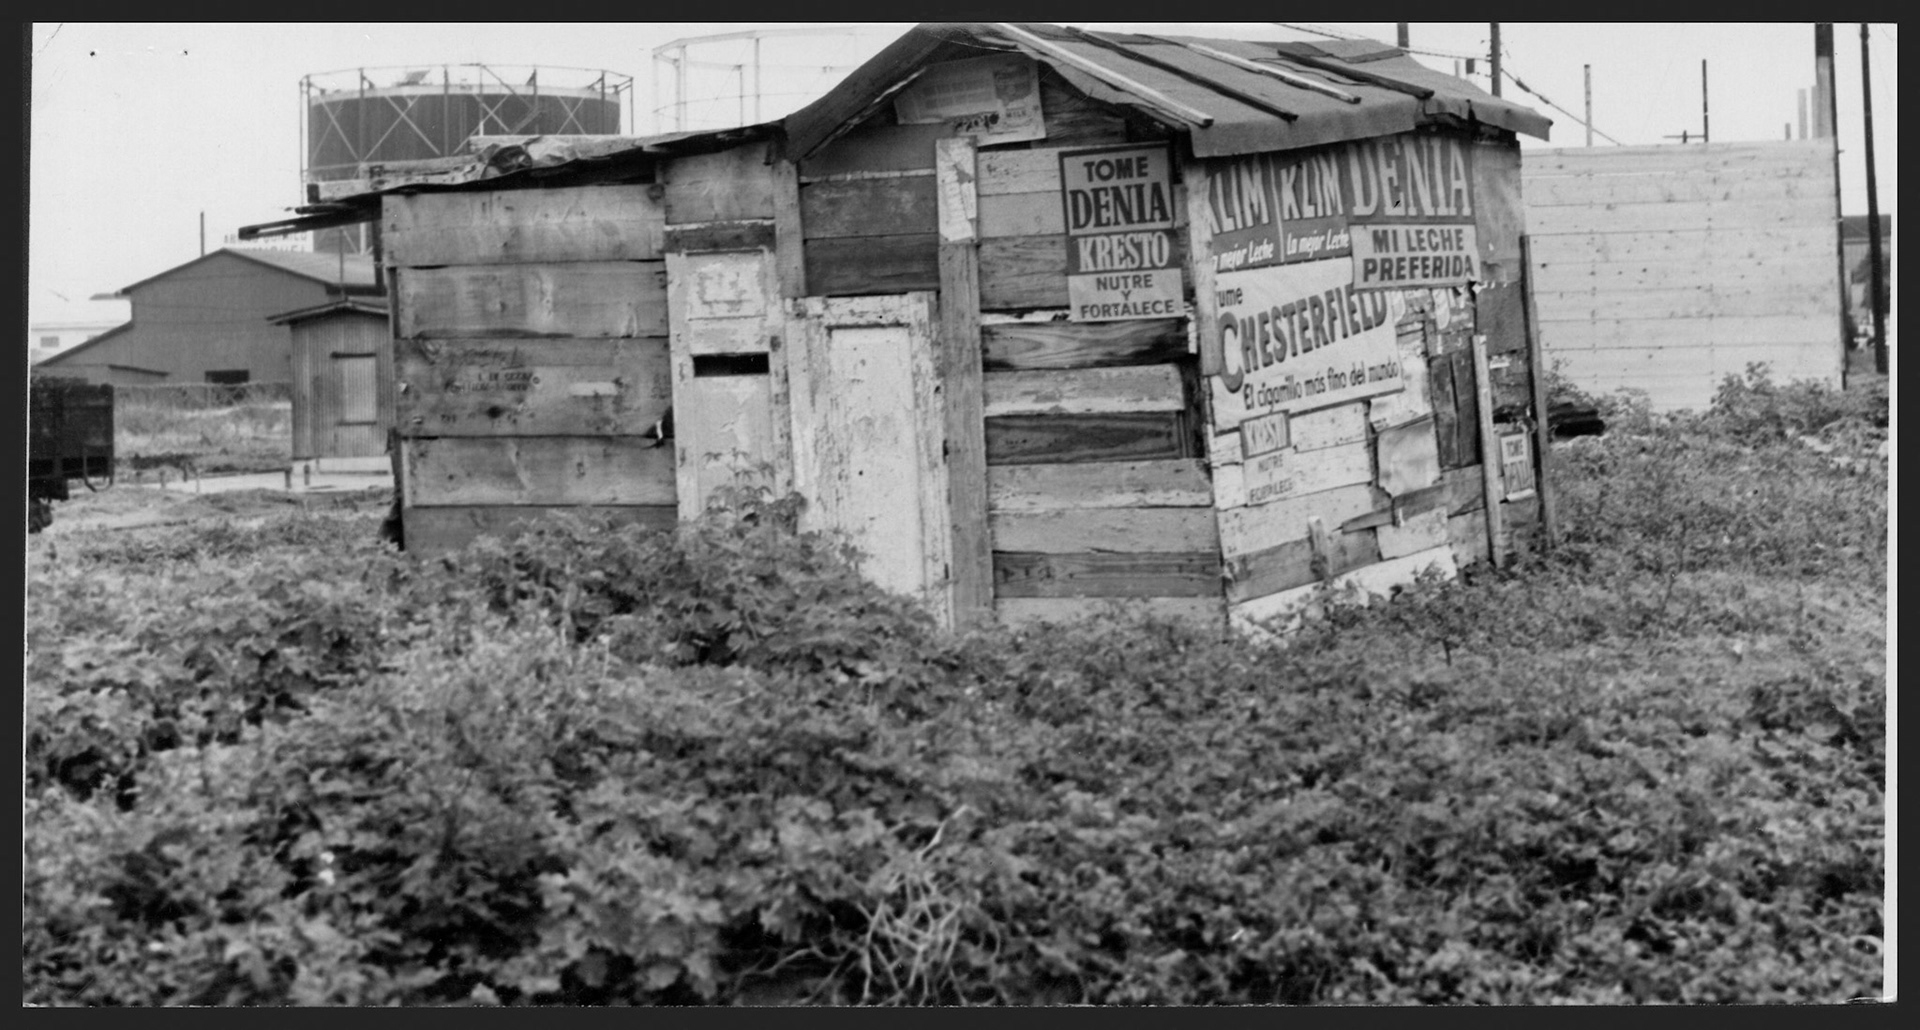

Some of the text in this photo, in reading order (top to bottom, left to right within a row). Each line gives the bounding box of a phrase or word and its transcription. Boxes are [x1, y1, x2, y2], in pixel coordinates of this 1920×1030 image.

[1083, 156, 1149, 182] TOME
[1350, 136, 1472, 217] DENIA
[1280, 151, 1343, 220] KLIM
[1069, 182, 1170, 229] DENIA
[1077, 231, 1170, 272] KRESTO
[1219, 243, 1247, 270] mejor
[1248, 238, 1274, 263] Leche
[1286, 228, 1350, 258] La mejor Leche
[1372, 228, 1465, 253] MI LECHE
[1096, 274, 1153, 291] NUTRE
[1363, 254, 1475, 282] PREFERIDA
[1080, 300, 1175, 319] FORTALECE
[1121, 290, 1131, 301] Y
[1218, 288, 1243, 307] ume
[1218, 282, 1388, 393] CHESTERFIELD
[1243, 382, 1255, 410] El
[1327, 366, 1347, 391] fino
[1350, 360, 1366, 386] del
[1368, 355, 1399, 383] mundo
